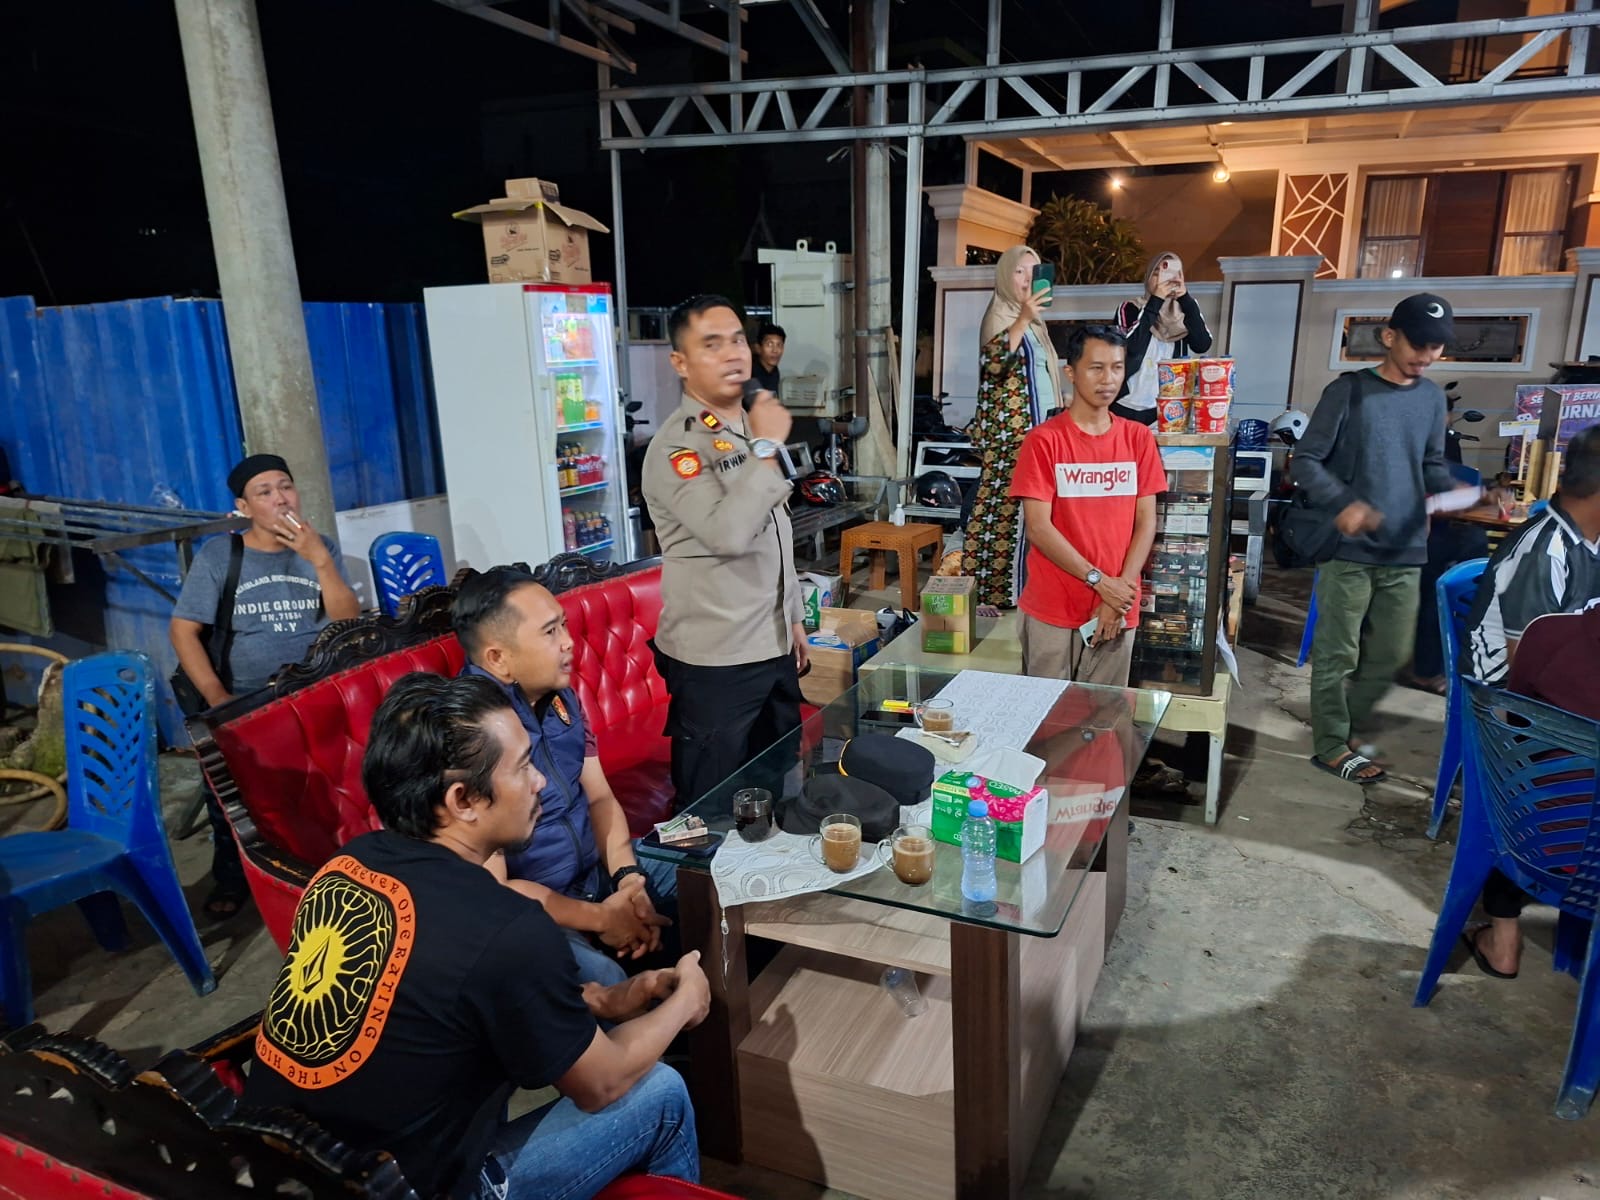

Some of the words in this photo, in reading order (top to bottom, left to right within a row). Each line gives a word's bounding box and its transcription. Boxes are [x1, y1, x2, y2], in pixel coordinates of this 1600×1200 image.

[337, 857, 399, 894] FOREVER
[287, 1062, 322, 1086] THE
[335, 1050, 362, 1078] ON
